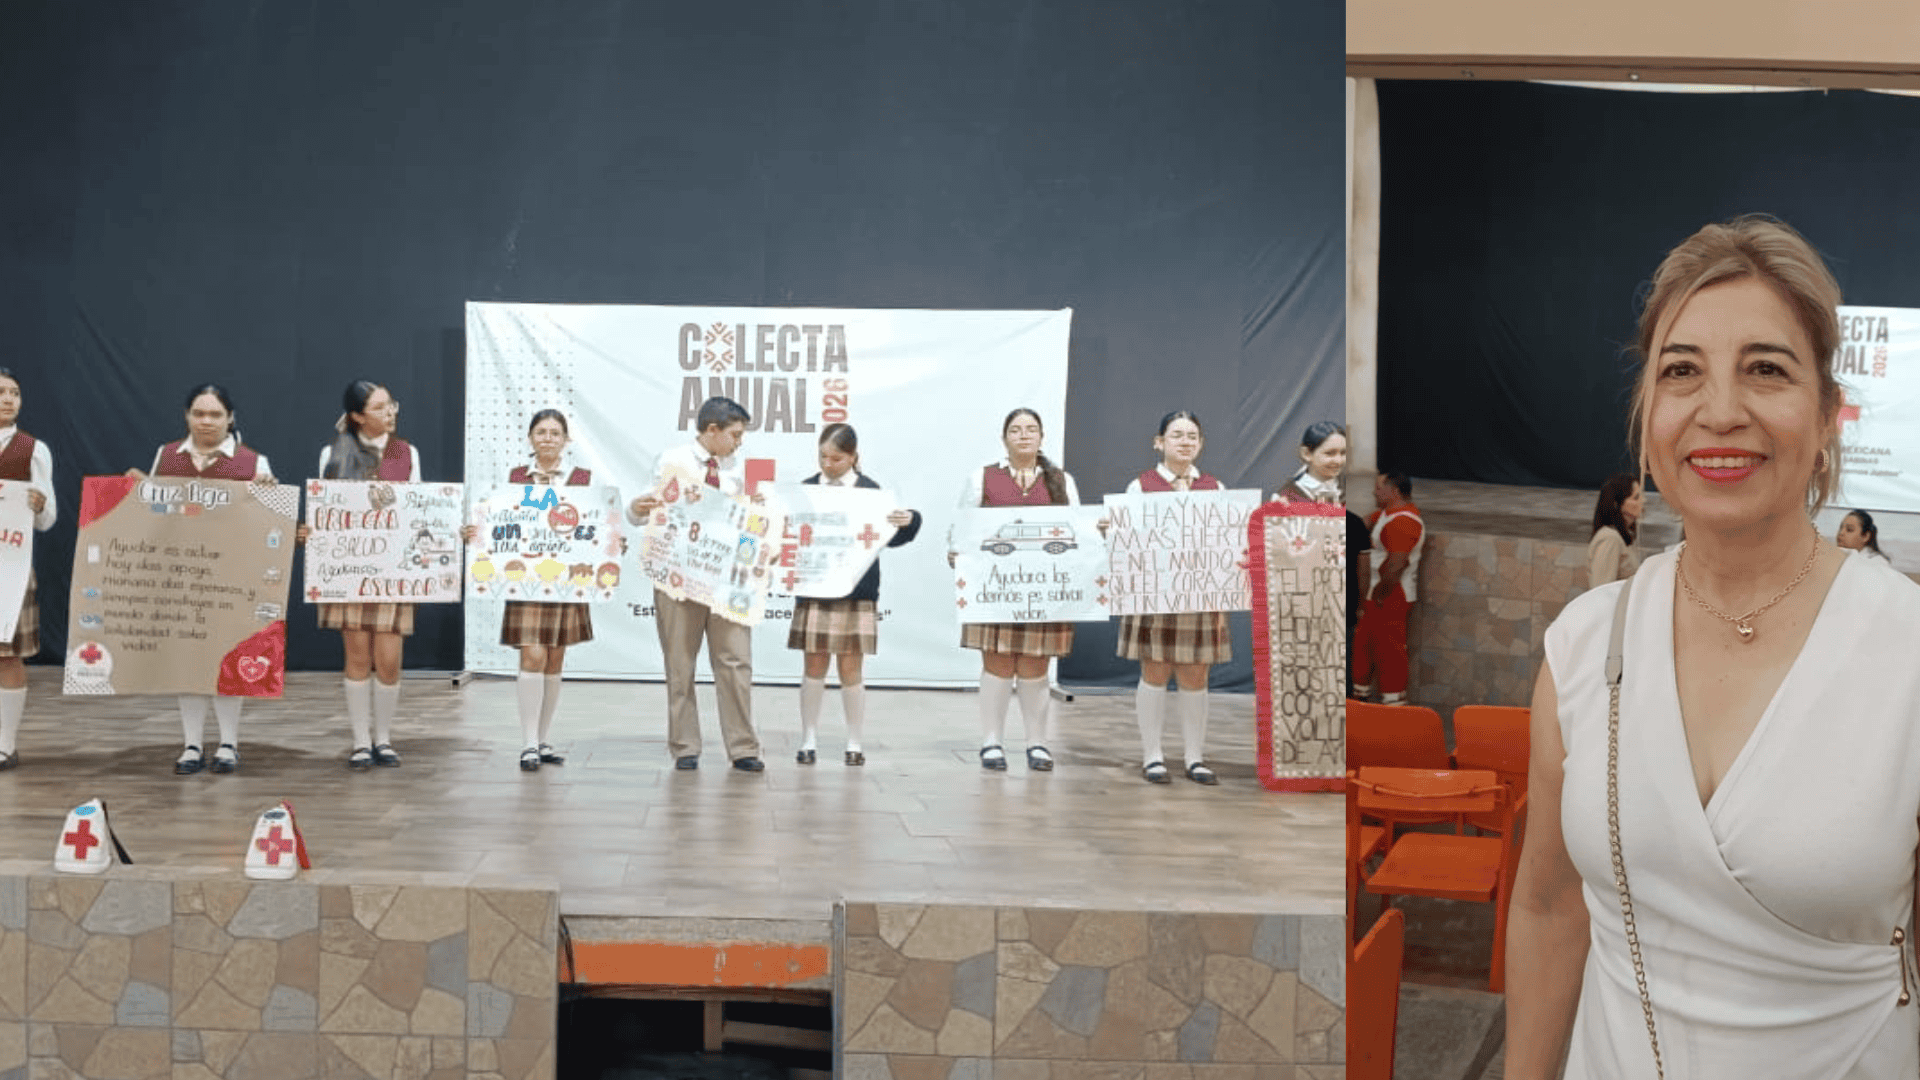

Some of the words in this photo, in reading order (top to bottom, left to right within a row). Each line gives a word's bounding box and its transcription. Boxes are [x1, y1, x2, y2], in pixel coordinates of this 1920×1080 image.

[1840, 315, 1889, 343] ECTA
[822, 379, 848, 425] 026
[520, 486, 558, 510] LA
[689, 521, 701, 543] 8
[1182, 526, 1246, 549] FUERT
[1312, 566, 1346, 595] PRO
[627, 603, 656, 616] "Est
[1281, 691, 1346, 717] COMP
